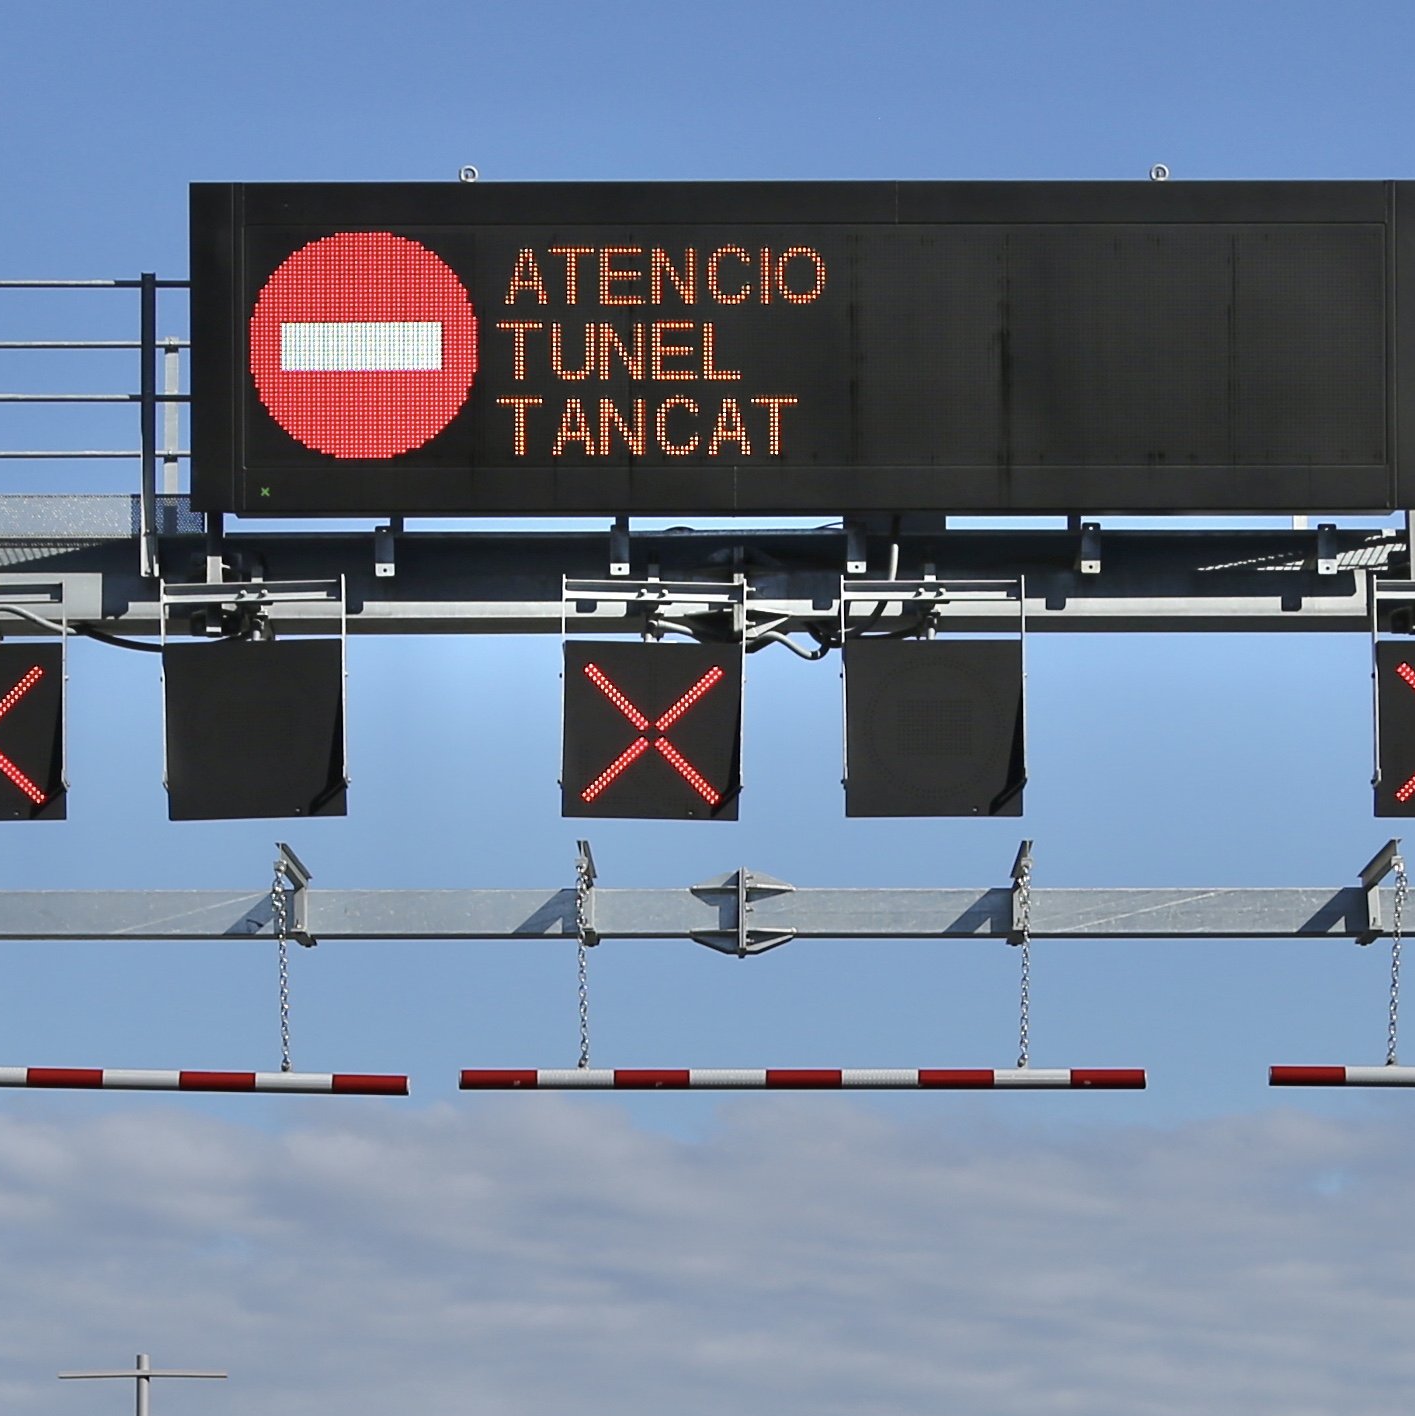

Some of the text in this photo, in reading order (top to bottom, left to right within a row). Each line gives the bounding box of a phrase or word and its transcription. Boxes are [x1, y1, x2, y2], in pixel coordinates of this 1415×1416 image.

[505, 245, 827, 305] ATENCIO
[496, 321, 742, 380] TUNEL
[496, 396, 798, 456] TANCAT
